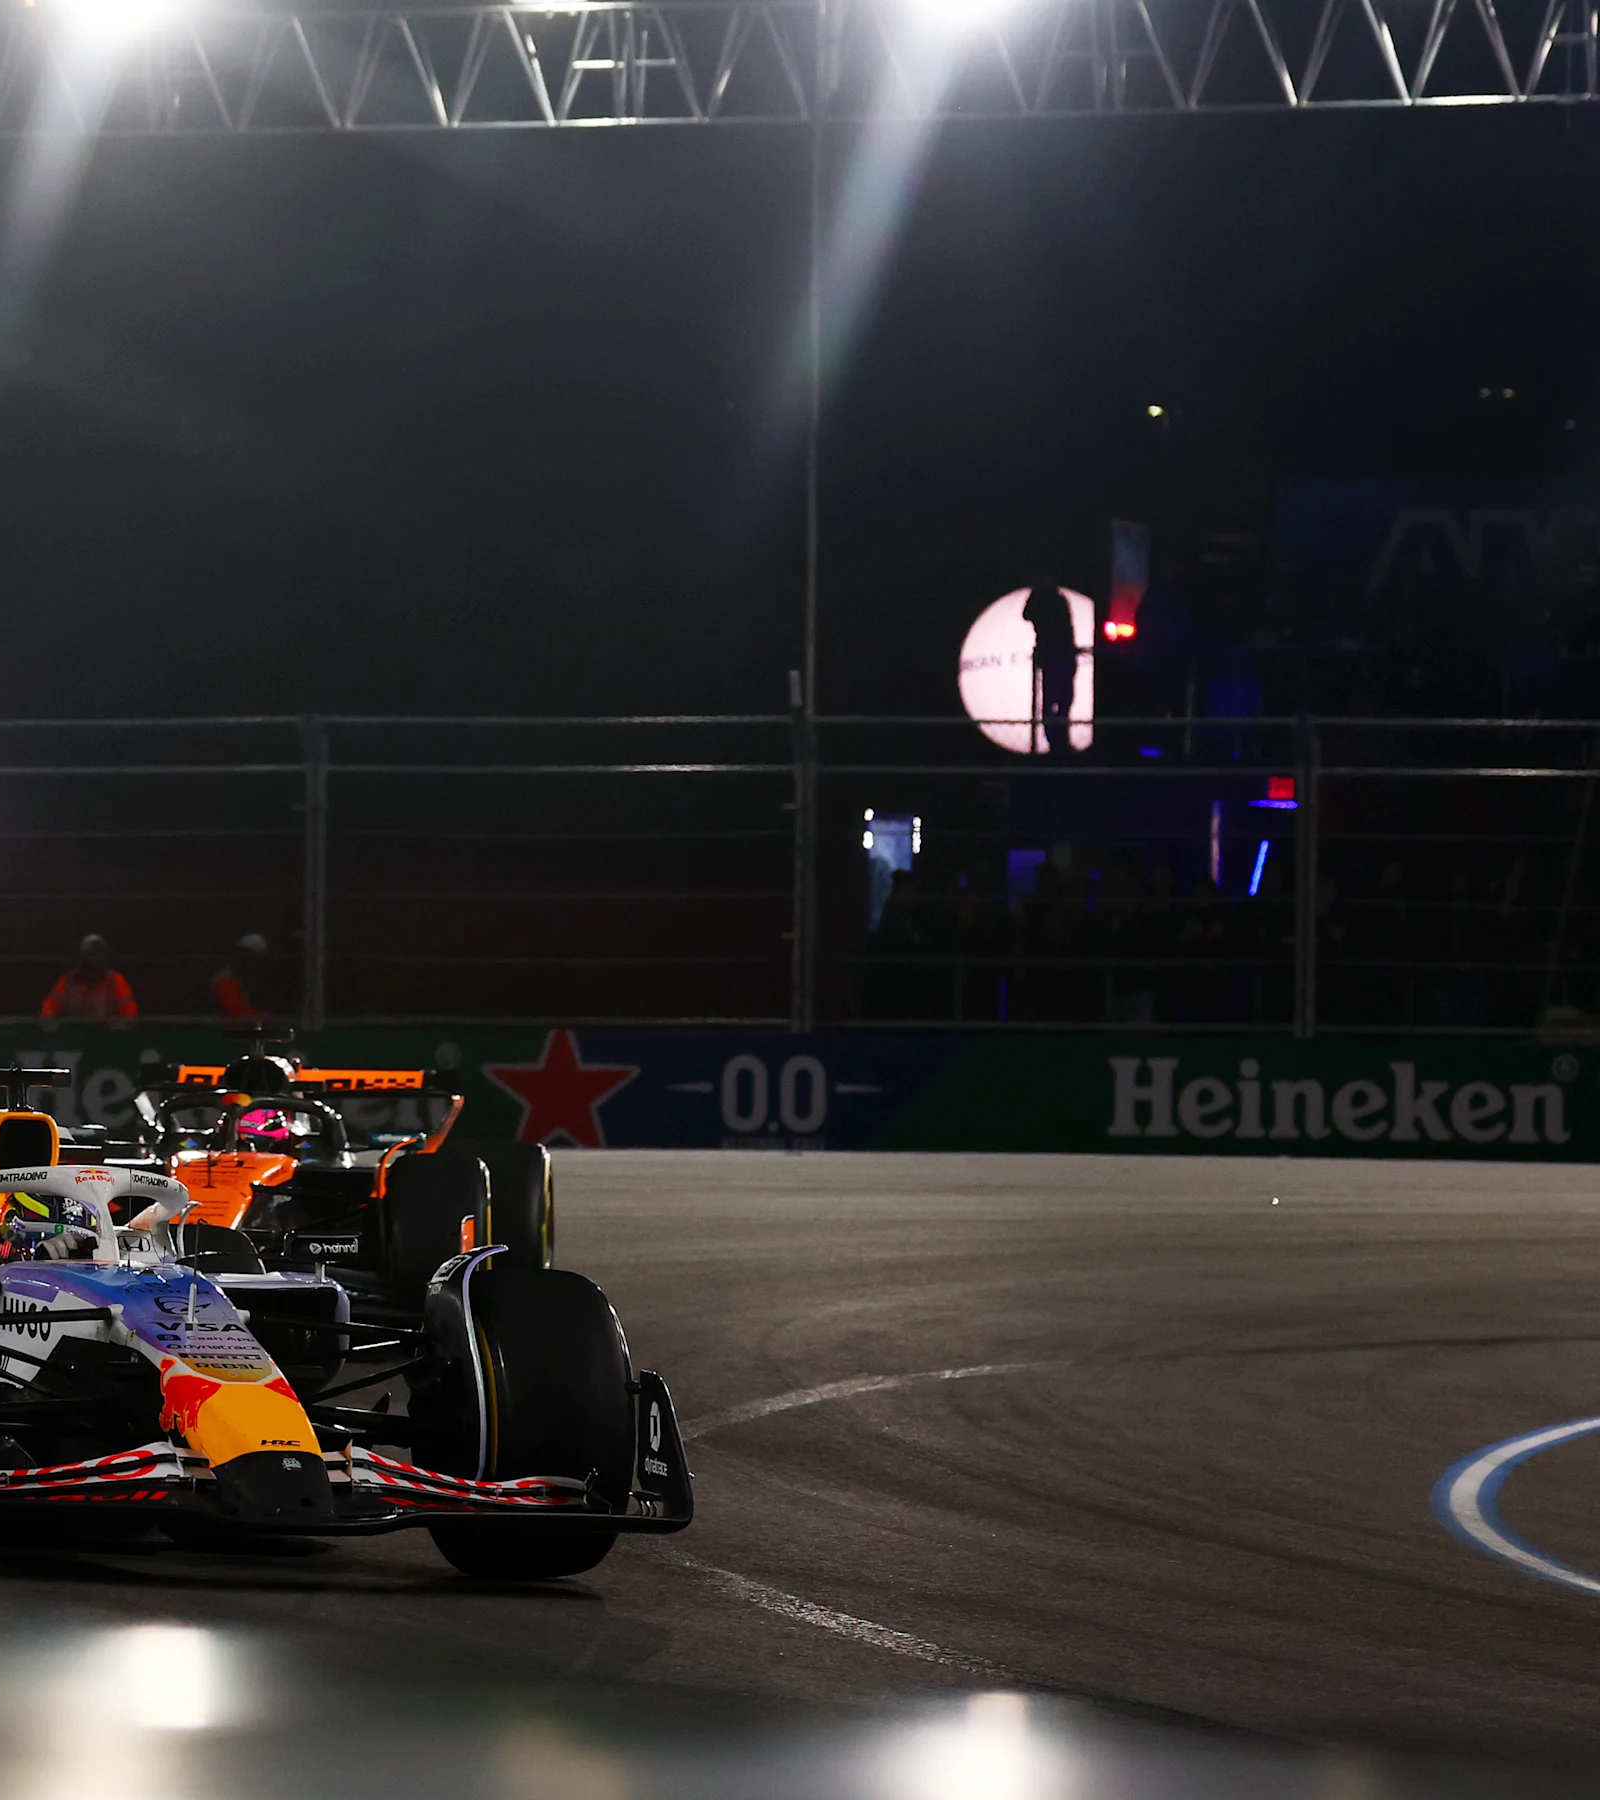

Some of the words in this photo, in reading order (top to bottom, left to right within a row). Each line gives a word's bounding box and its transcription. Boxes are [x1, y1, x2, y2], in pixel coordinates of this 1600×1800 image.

[721, 1053, 828, 1134] 0.0
[1108, 1056, 1572, 1144] Heineken
[74, 1175, 96, 1186] Red
[97, 1176, 115, 1186] Bull
[149, 1322, 249, 1333] VISA
[644, 1454, 668, 1477] dynatrace
